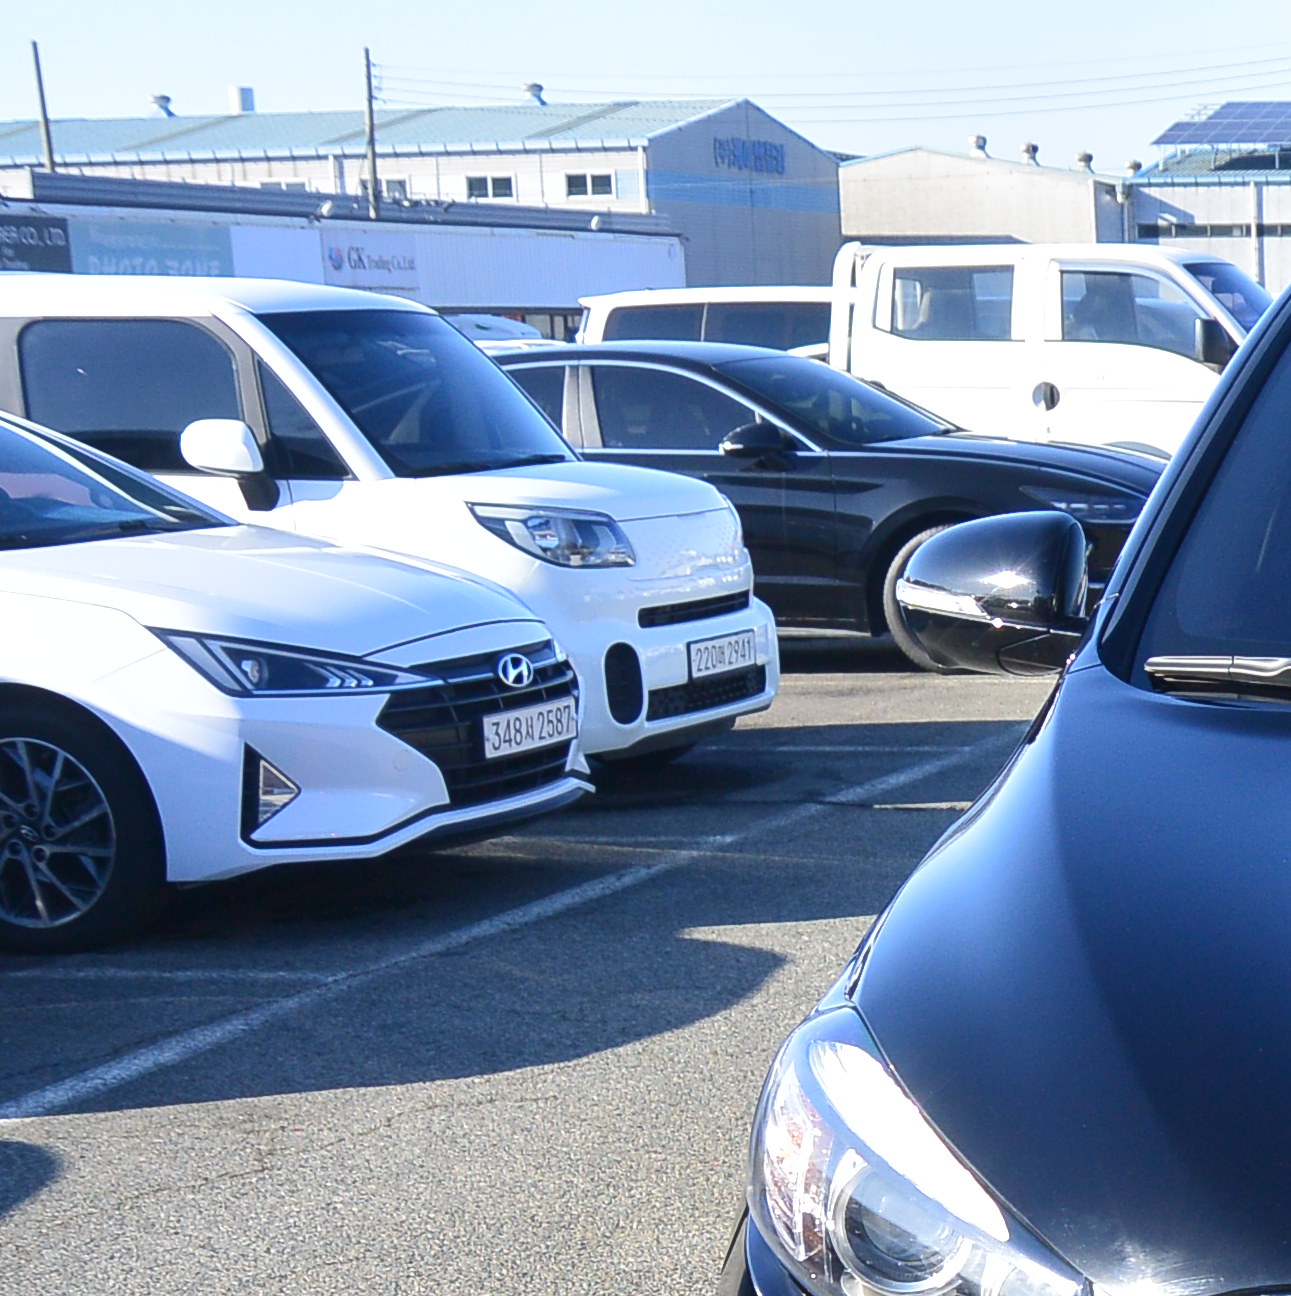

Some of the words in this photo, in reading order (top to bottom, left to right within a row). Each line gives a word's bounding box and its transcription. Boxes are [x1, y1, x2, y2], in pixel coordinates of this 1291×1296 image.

[347, 246, 367, 270] GK
[727, 636, 752, 666] 2941
[491, 714, 535, 751] 348서
[537, 704, 572, 741] 2587
